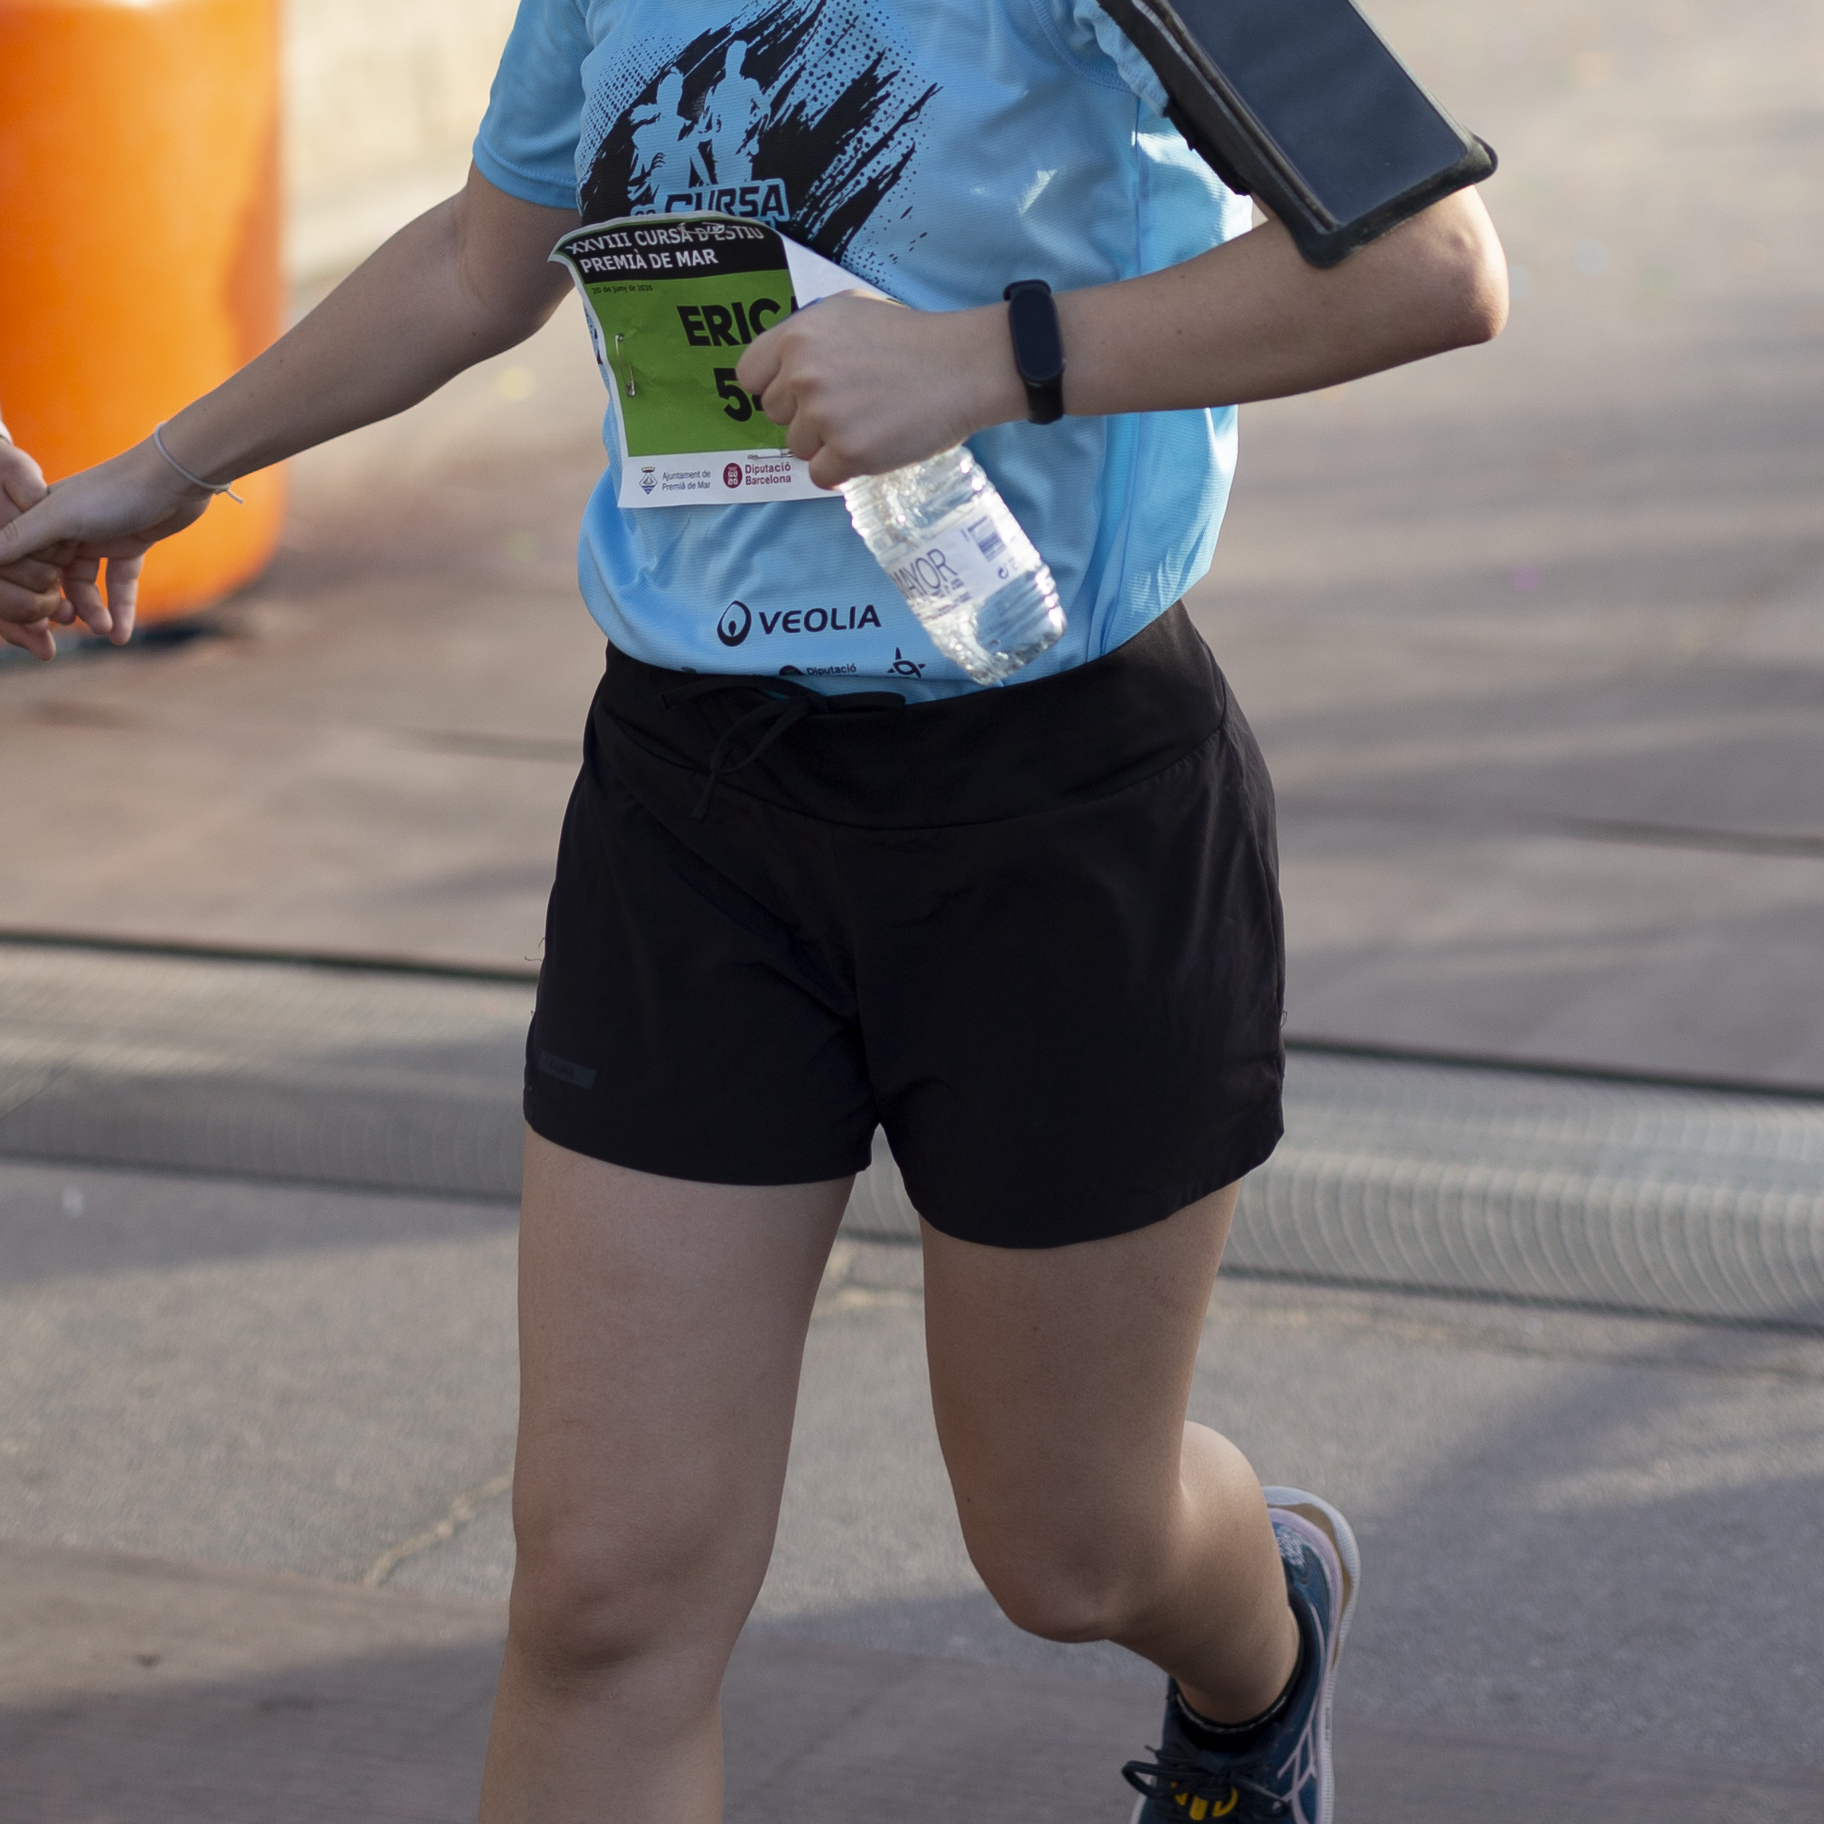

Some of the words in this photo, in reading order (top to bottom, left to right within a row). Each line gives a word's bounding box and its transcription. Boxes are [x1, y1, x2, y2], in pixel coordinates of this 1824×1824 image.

[665, 184, 781, 218] CURSA
[565, 232, 633, 255] XXVIII
[634, 228, 694, 246] CURSA
[580, 249, 648, 273] PREMIÀ
[649, 253, 673, 269] DE
[676, 249, 719, 267] MAR
[676, 297, 798, 346] ERIC
[702, 470, 711, 478] de
[745, 462, 791, 475] Diputació
[745, 474, 791, 486] Barcelona
[688, 481, 695, 489] de
[697, 480, 711, 489] Mar
[759, 604, 882, 635] VEOLIA
